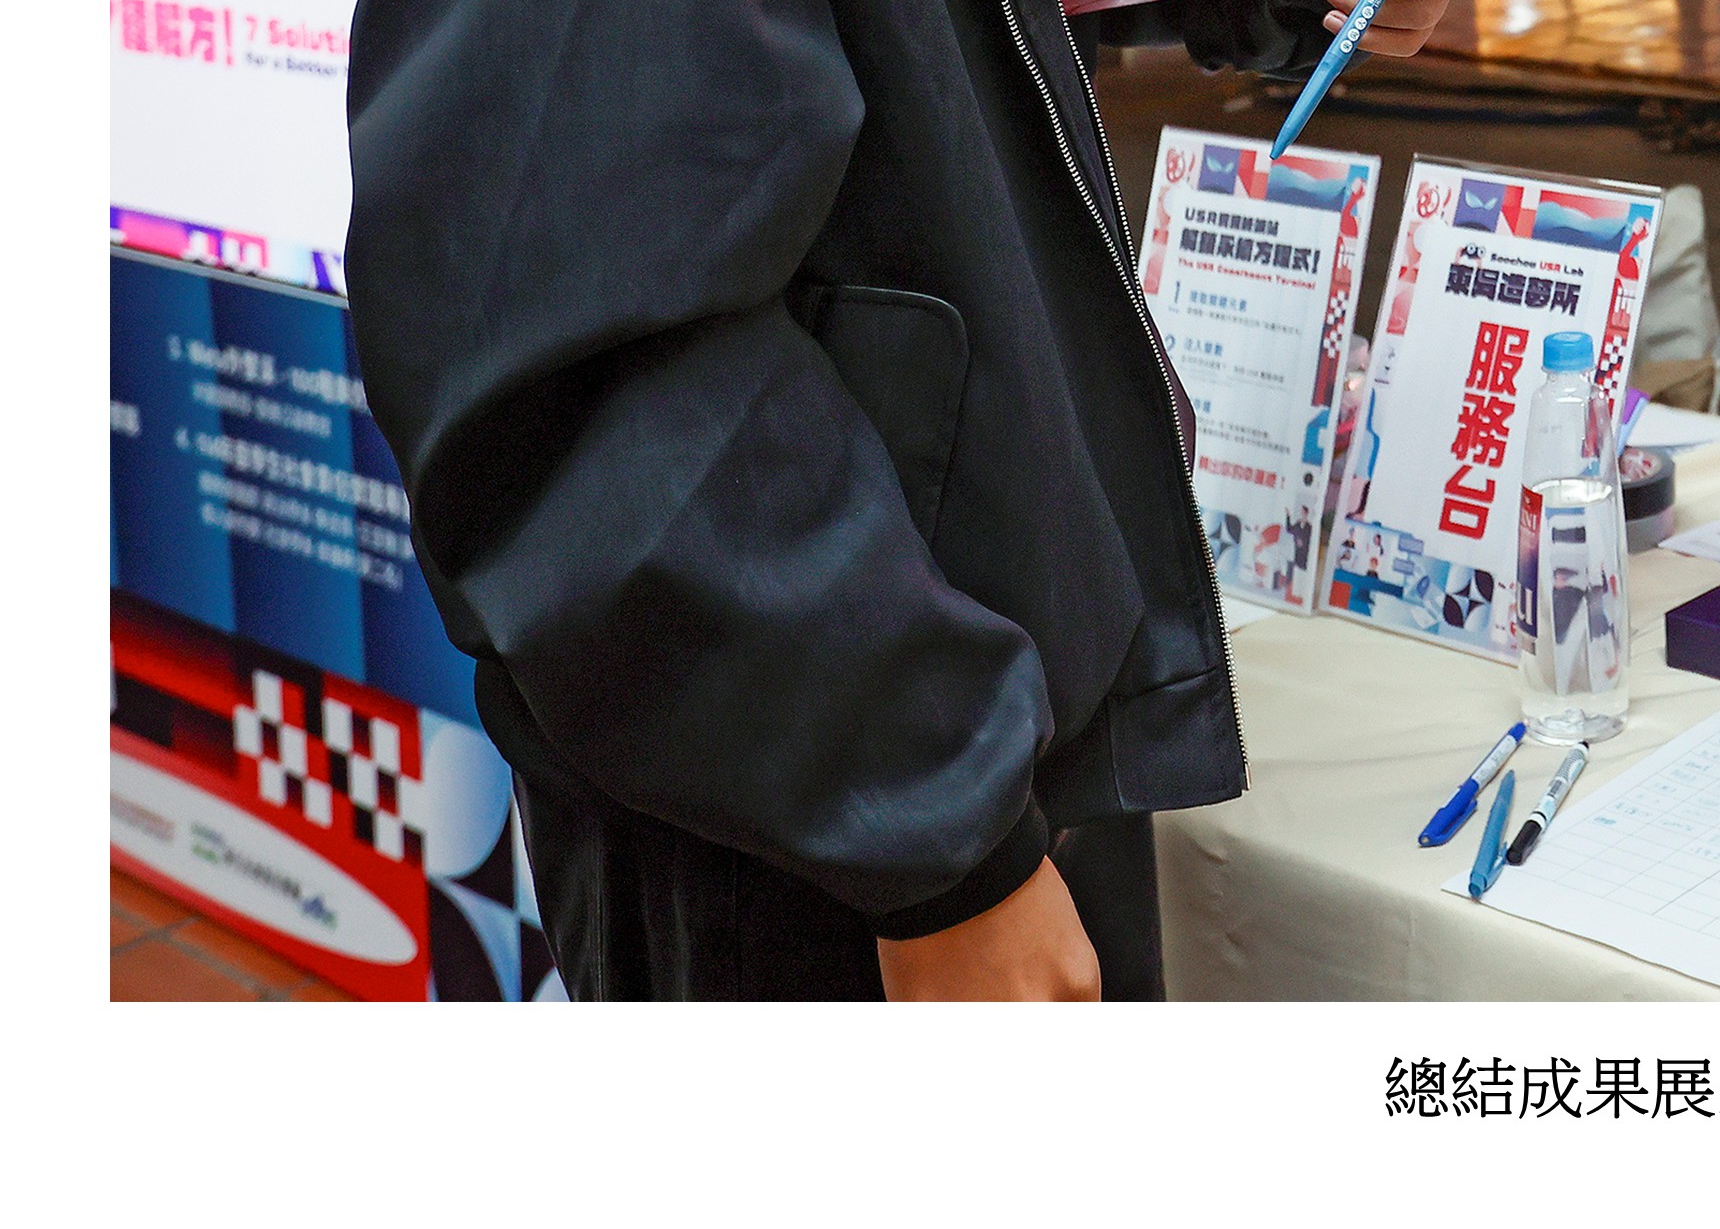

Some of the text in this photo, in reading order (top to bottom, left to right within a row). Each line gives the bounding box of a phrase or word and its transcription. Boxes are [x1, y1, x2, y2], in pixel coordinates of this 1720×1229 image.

[1539, 260, 1562, 273] USR
[1563, 265, 1584, 278] Lab
[1438, 321, 1530, 539] 服務台
